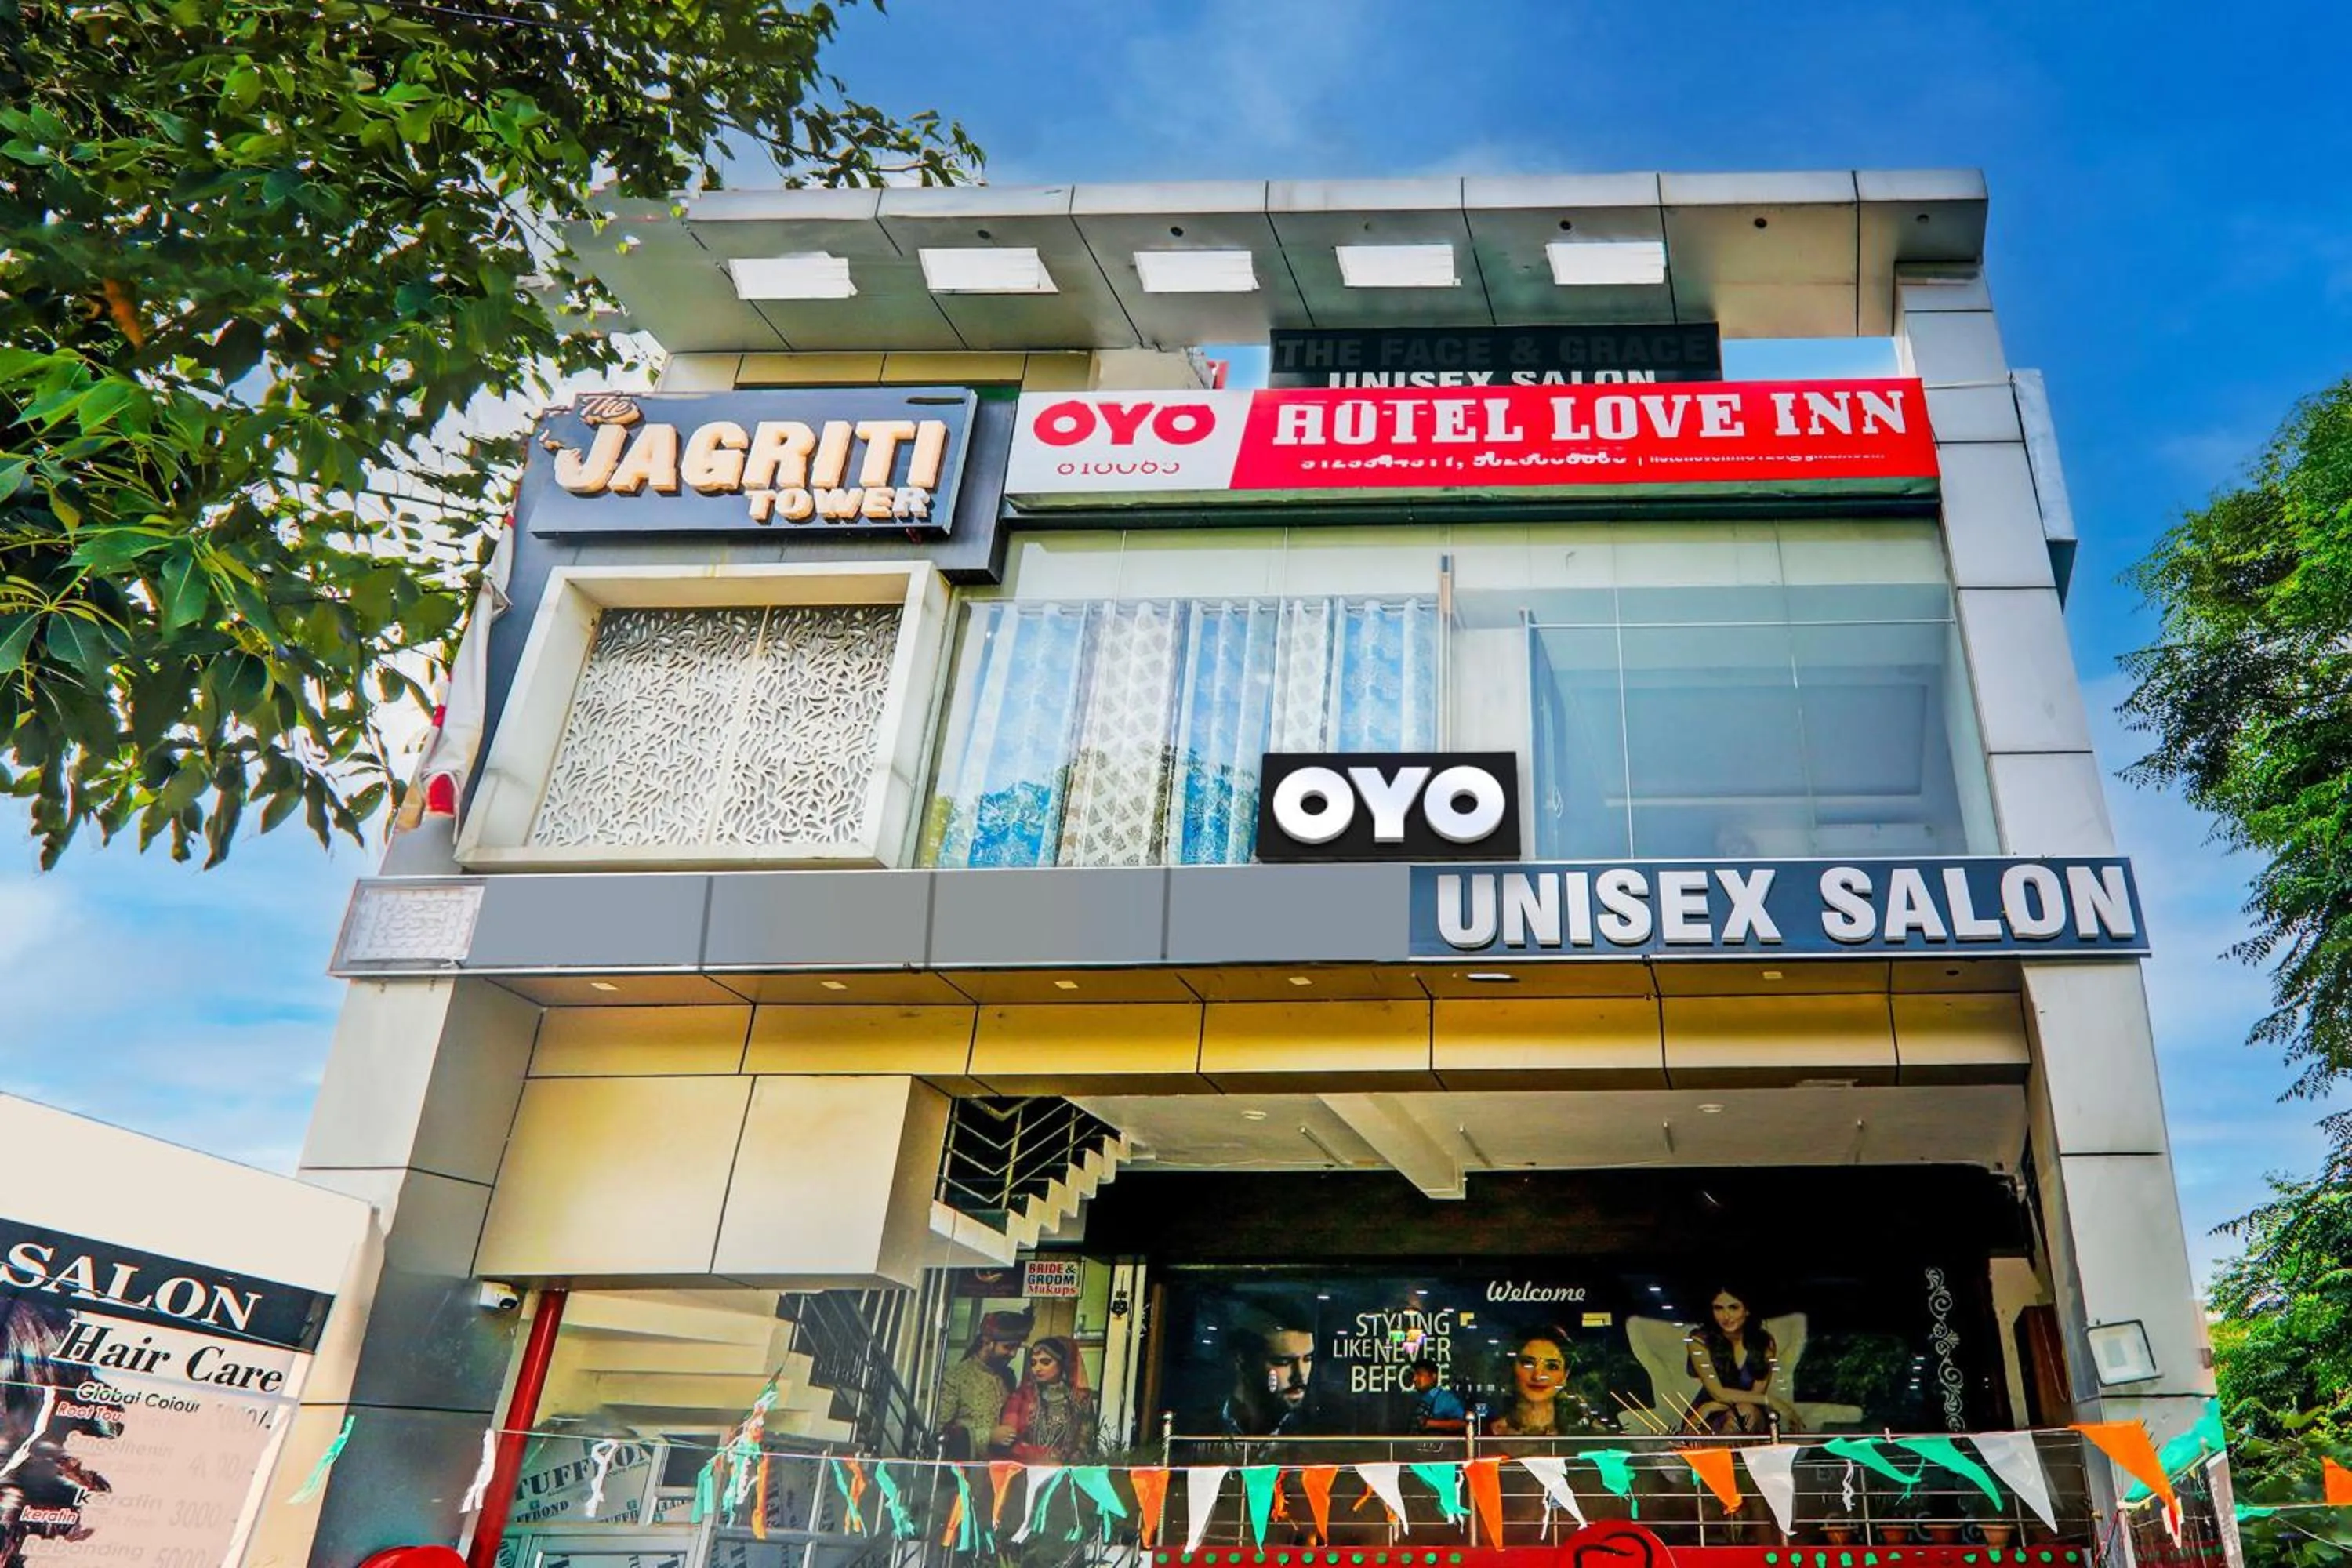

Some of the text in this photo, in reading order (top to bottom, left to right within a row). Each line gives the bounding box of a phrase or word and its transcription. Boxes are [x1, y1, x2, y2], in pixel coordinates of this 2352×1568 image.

[1278, 333, 1709, 367] THE FACE & GRACE
[1033, 400, 1217, 446] OYO
[1272, 390, 1907, 446] HOTEL LOVE INN
[554, 419, 950, 495] JAGRITI
[745, 486, 933, 524] TOWER
[1272, 765, 1506, 844] OYO
[1437, 864, 2137, 949] UNISEX SALON
[0, 1240, 263, 1331] SALON
[1028, 1262, 1076, 1275] BRIDE &
[1028, 1274, 1075, 1285] GROOM
[1486, 1280, 1586, 1303] Welcome
[51, 1319, 283, 1394] Hair Care
[1334, 1338, 1372, 1358] LIKE
[1351, 1363, 1450, 1393] BEFOE
